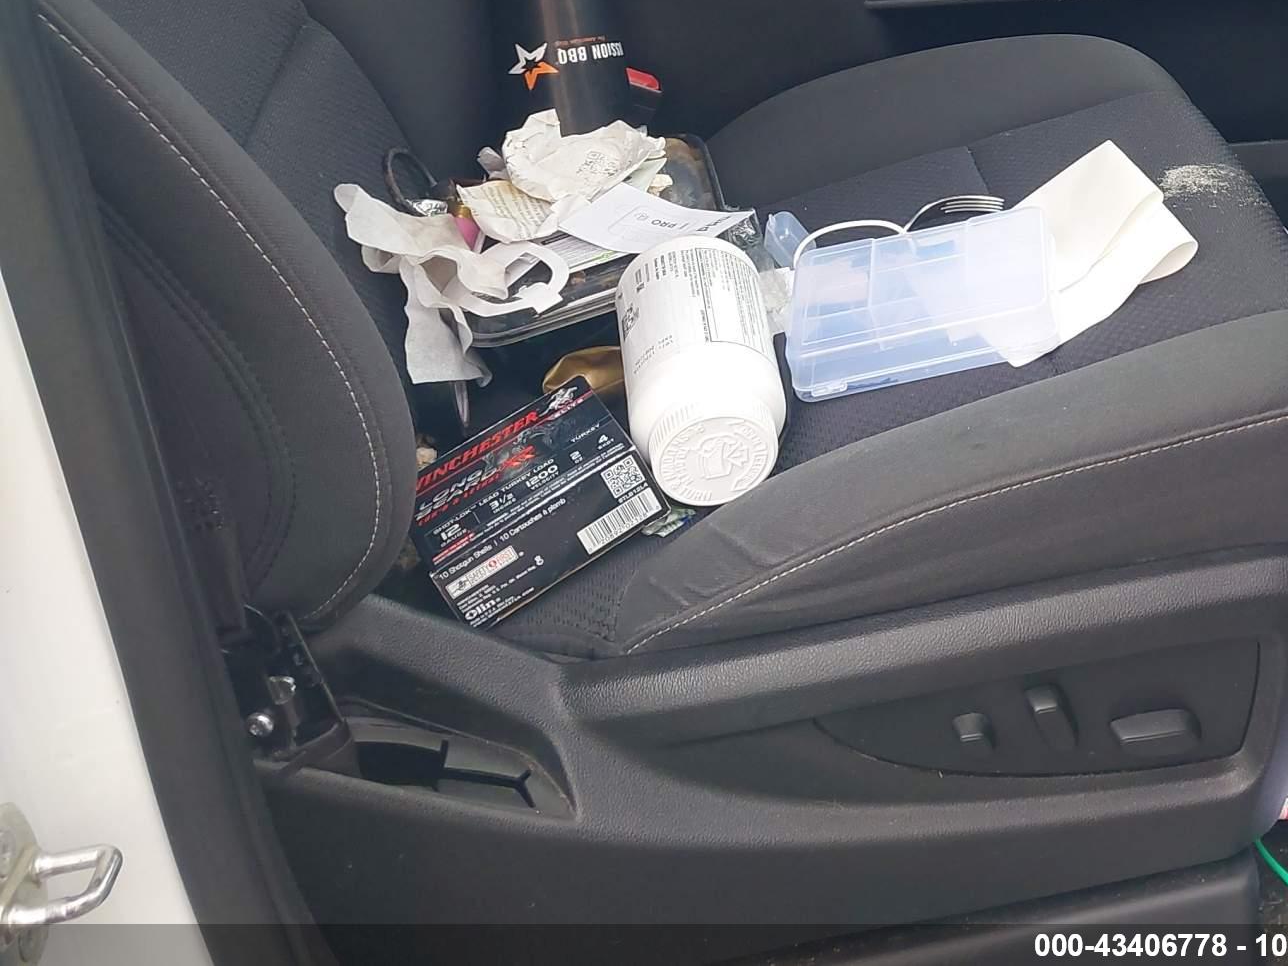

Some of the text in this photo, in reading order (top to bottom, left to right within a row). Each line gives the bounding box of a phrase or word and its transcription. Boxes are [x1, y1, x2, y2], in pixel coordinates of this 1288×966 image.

[557, 45, 588, 65] BBQ
[597, 434, 609, 444] 4
[569, 450, 581, 461] 2
[478, 490, 501, 507] LEAD
[500, 471, 532, 493] TURKEY
[532, 458, 555, 474] LOAD
[524, 464, 559, 489] 1200
[420, 469, 482, 511] LONG
[440, 522, 462, 542] 12
[499, 531, 511, 543] 10
[509, 512, 544, 537] Cartouches
[547, 497, 567, 515] plomb
[438, 570, 450, 581] 10
[448, 556, 475, 576] Shotgun
[473, 543, 493, 558] Shells
